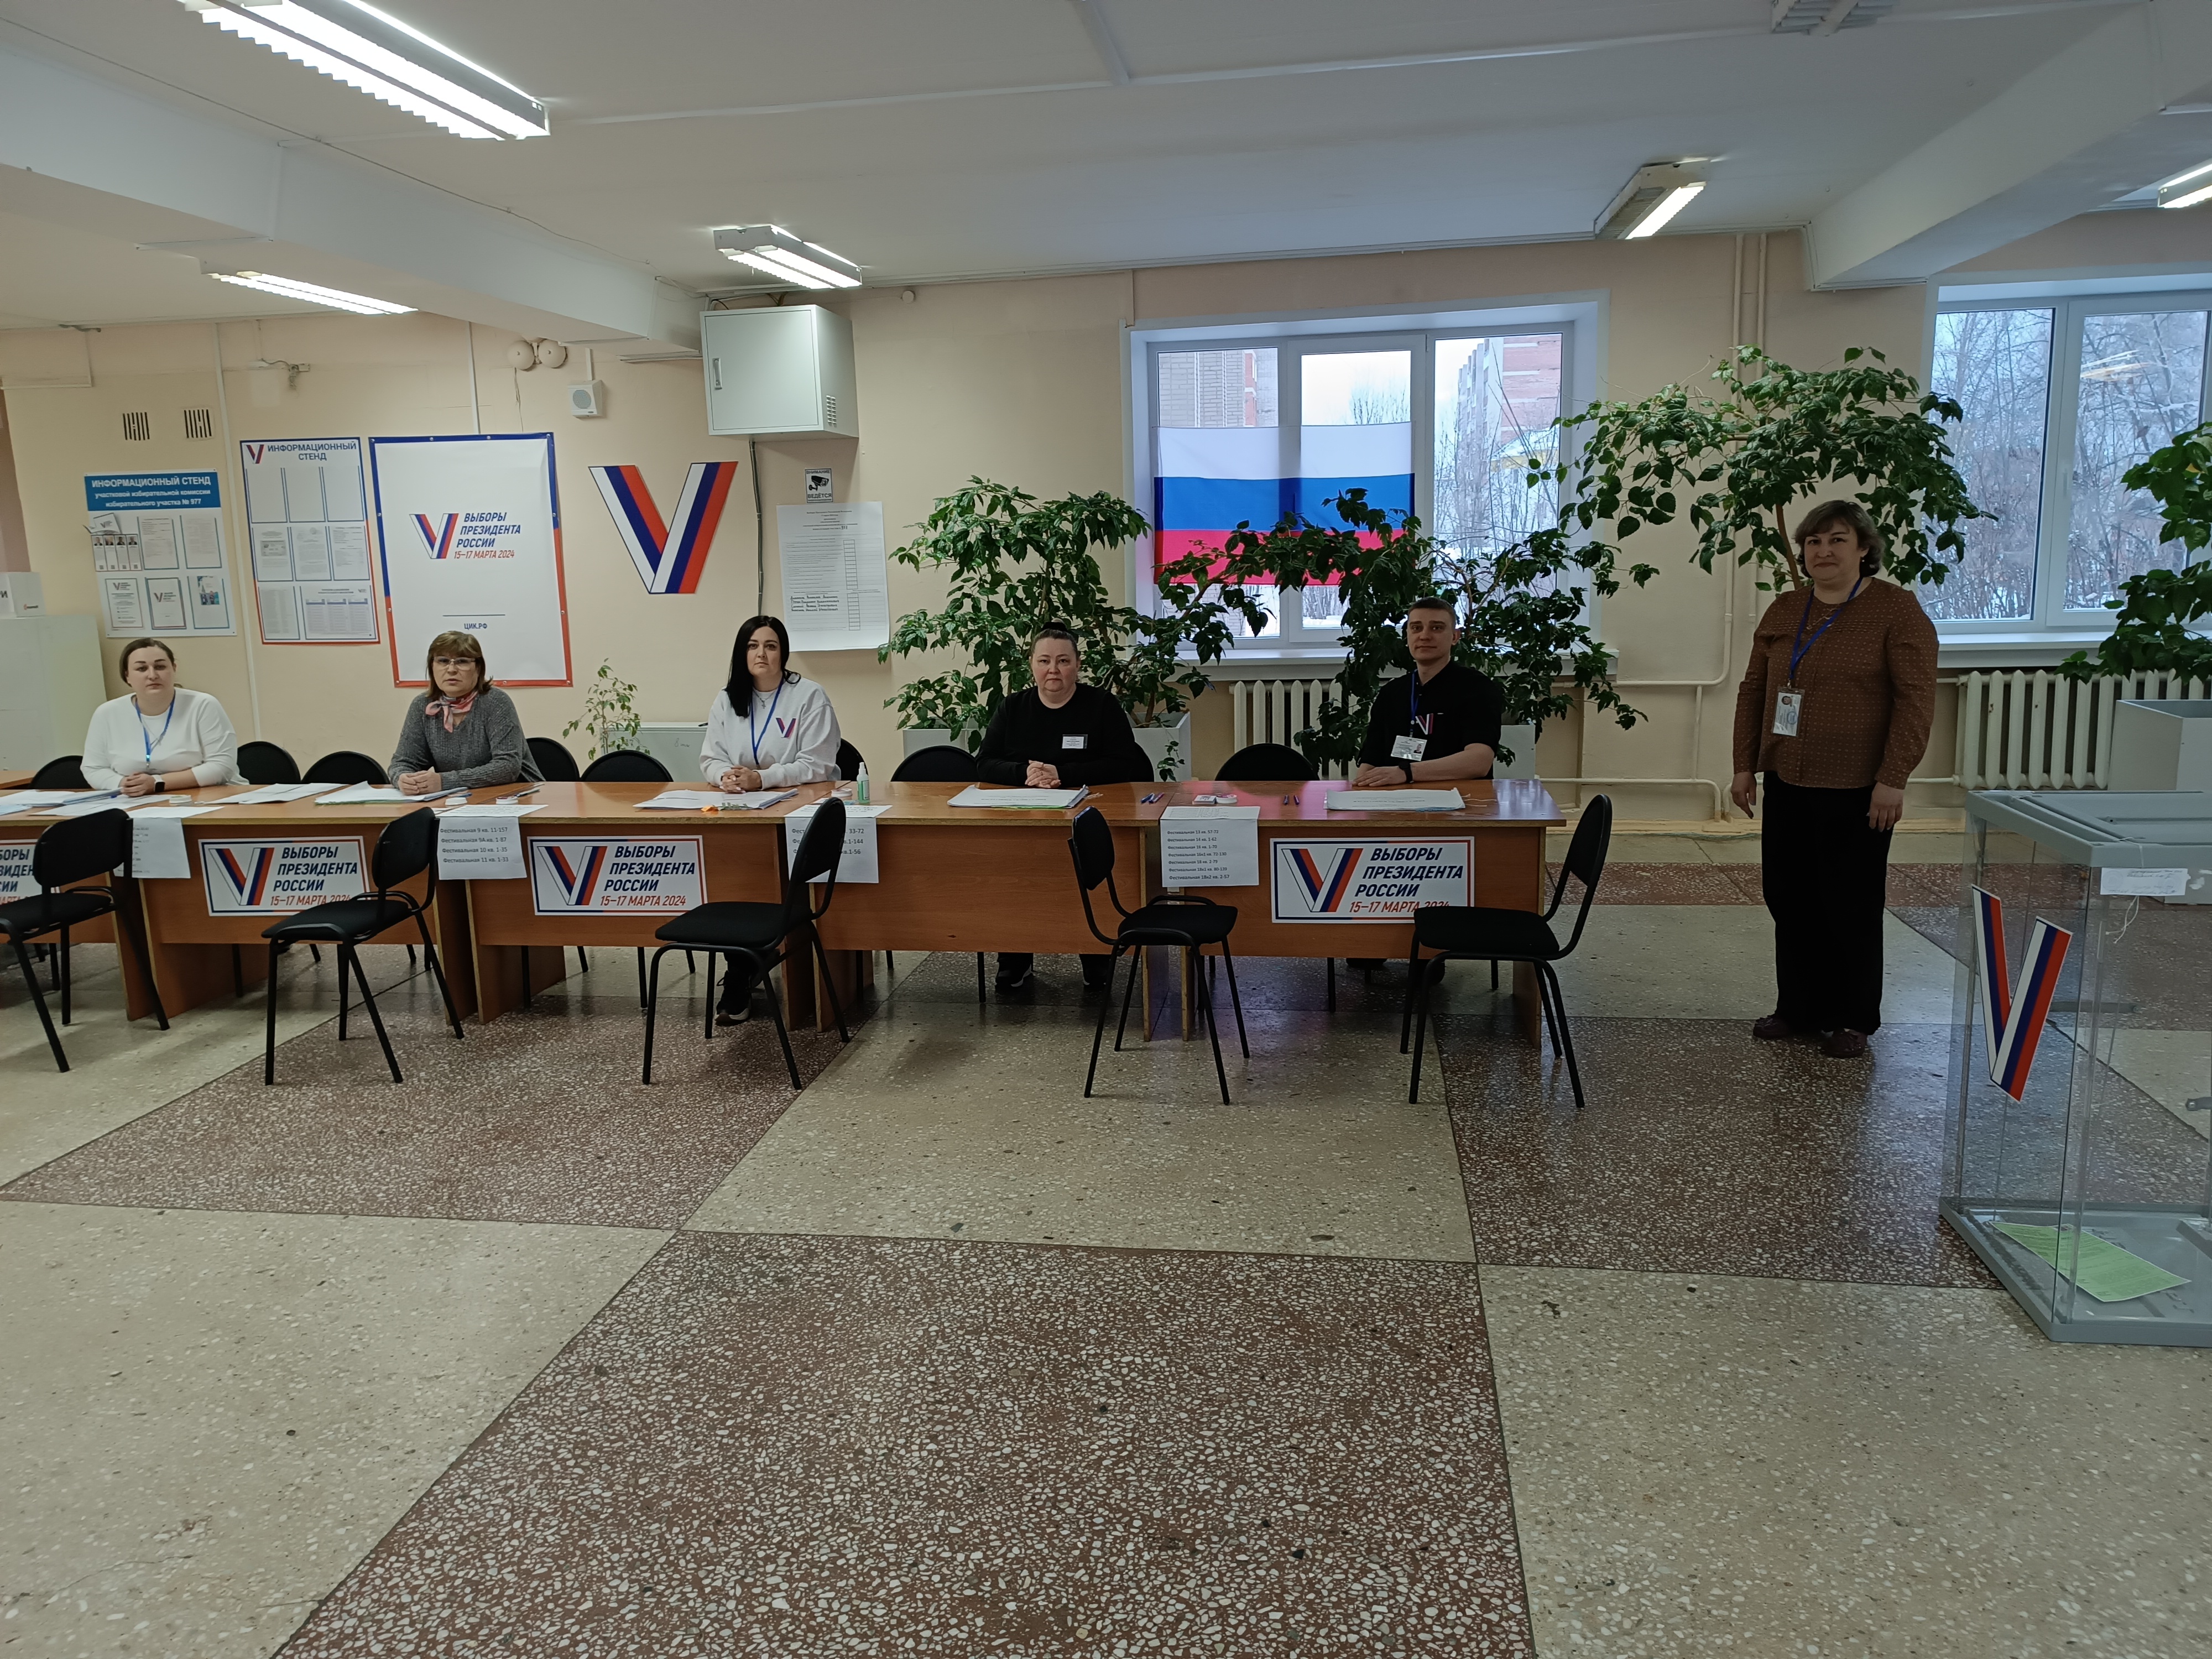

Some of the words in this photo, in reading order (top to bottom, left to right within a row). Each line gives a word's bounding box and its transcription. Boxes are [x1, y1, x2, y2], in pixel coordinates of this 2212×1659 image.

[268, 441, 357, 452] ИНФОРМАЦИОННЫЙ
[298, 452, 327, 461] СТЕНД
[92, 476, 180, 488] ИНФОРМАЦИОННЫЙ
[182, 476, 211, 486] СТЕНД
[463, 512, 507, 522] ВЫБОРЫ
[460, 524, 521, 536] ПРЕЗИДЕНТА
[456, 538, 495, 548] РОССИИ
[473, 550, 497, 559] МАРТА
[498, 550, 515, 559] 2024
[281, 846, 339, 859] ВЫБОРЫ
[614, 846, 676, 858] ВЫБОРЫ
[1370, 847, 1443, 861] ВЫБОРЫ
[277, 862, 357, 877] ПРЕЗИДЕНТА
[609, 862, 695, 877] ПРЕЗИДЕНТА
[1362, 865, 1463, 881] ПРЕЗИДЕНТА
[0, 881, 18, 892] ИИ
[273, 879, 325, 891] РОССИИ
[604, 879, 660, 891] РОССИИ
[1354, 884, 1420, 897] РОССИИ
[296, 895, 327, 905] МАРТА
[628, 895, 660, 906] МАРТА
[662, 895, 686, 906] 2024
[1381, 901, 1420, 912] МАРТА
